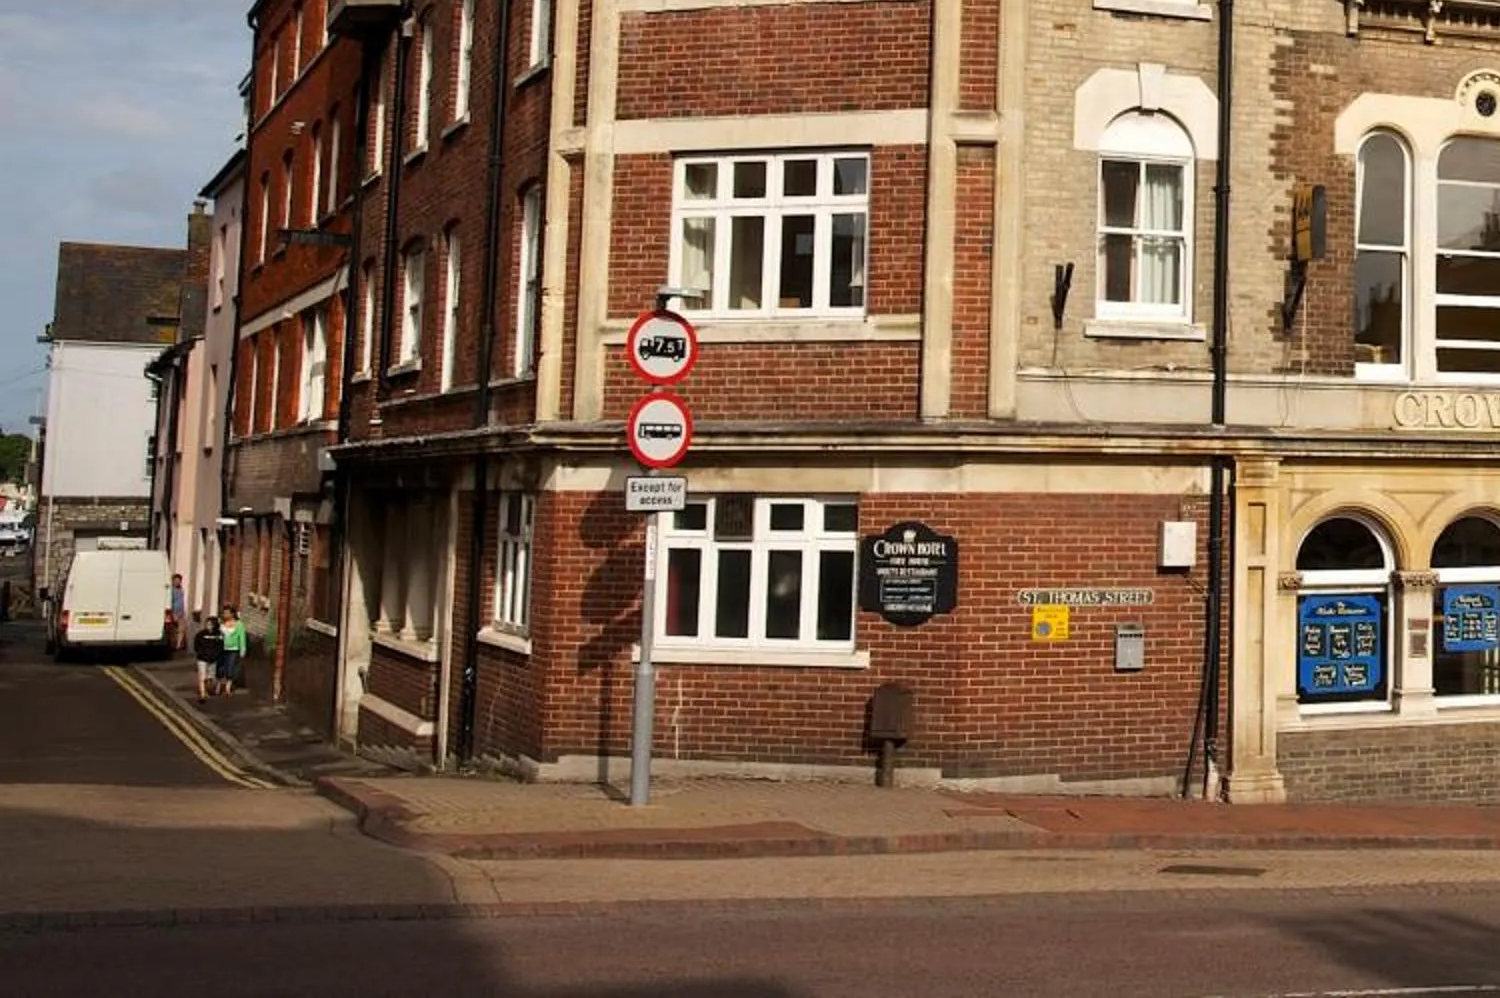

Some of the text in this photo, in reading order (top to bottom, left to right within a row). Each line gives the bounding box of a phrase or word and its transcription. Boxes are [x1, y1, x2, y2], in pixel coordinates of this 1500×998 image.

[631, 482, 682, 494] Except for
[640, 496, 673, 505] access
[873, 540, 947, 558] CROWN HOTEL
[1049, 590, 1100, 603] THOMAS
[1104, 590, 1149, 603] STREET
